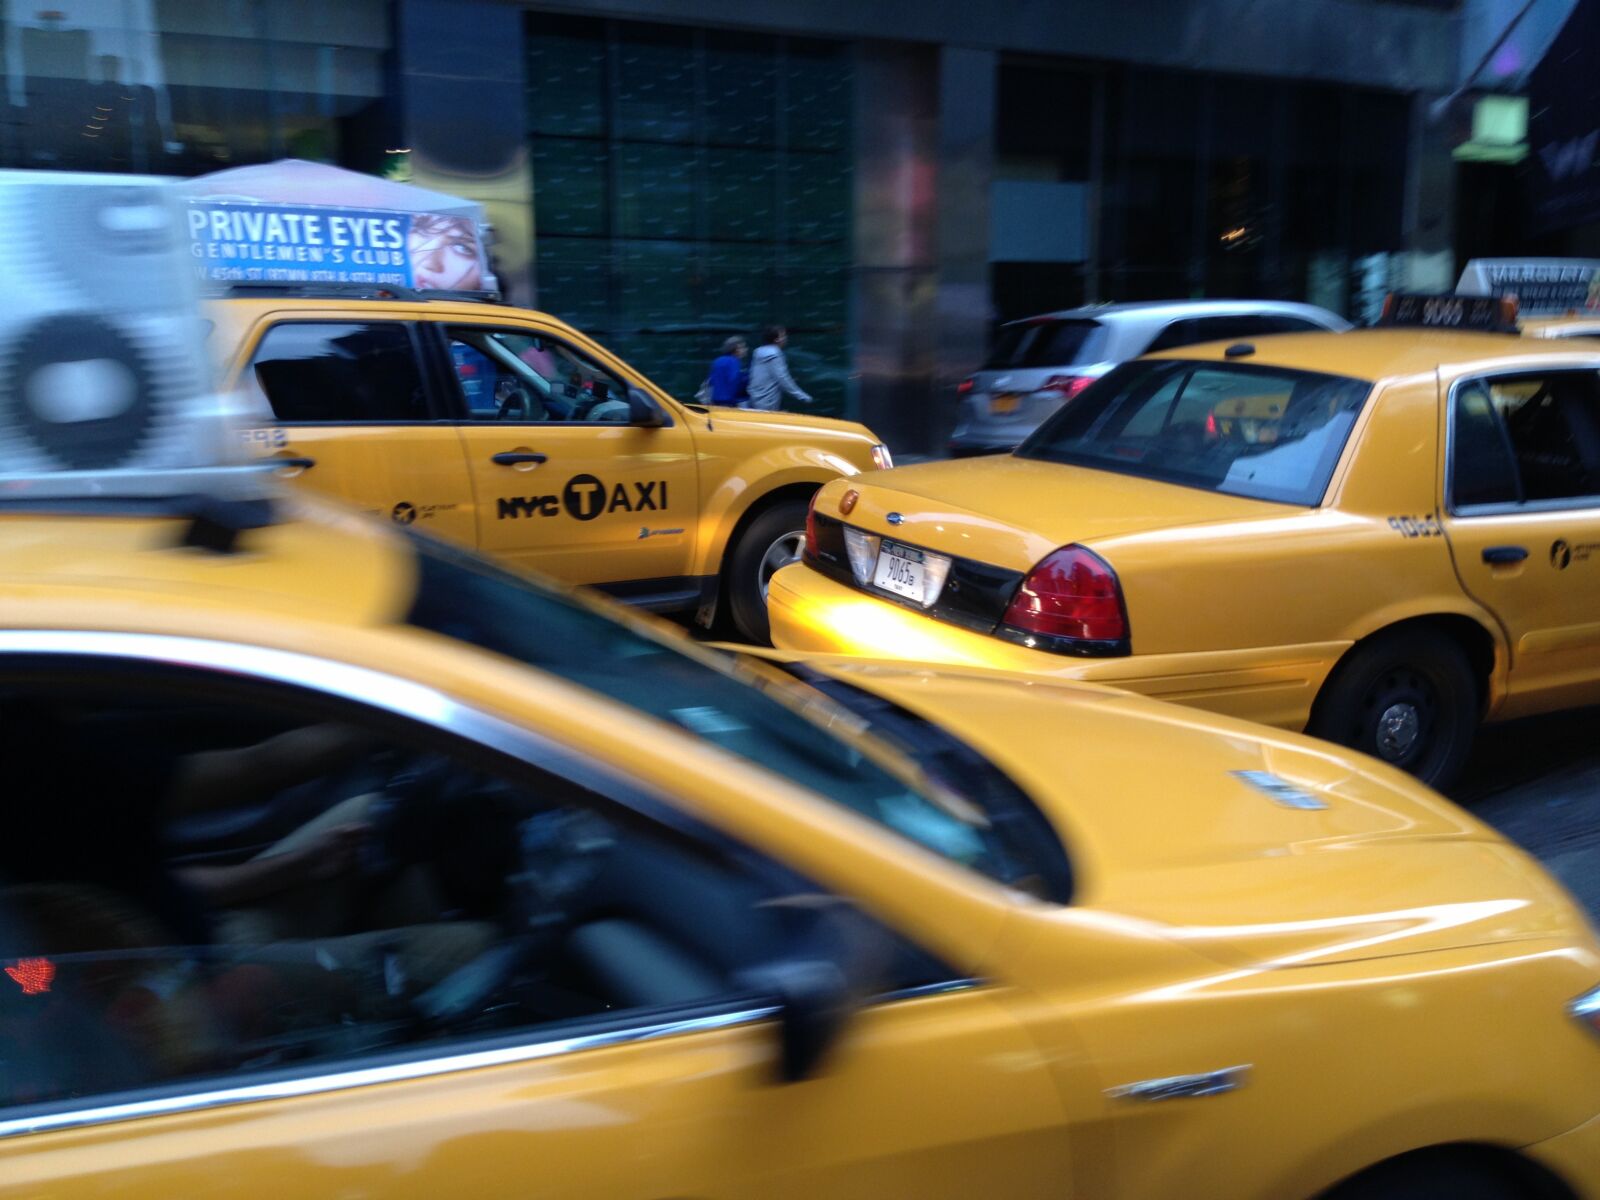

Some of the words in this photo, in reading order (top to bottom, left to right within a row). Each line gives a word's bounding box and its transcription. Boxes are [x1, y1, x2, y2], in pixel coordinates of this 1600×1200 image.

[187, 209, 323, 245] PRIVATE
[328, 216, 404, 249] EYES
[191, 242, 345, 263] GENTLEMEN'S
[351, 249, 405, 266] CLUB
[497, 495, 560, 519] NYC
[564, 474, 668, 520] TAXI
